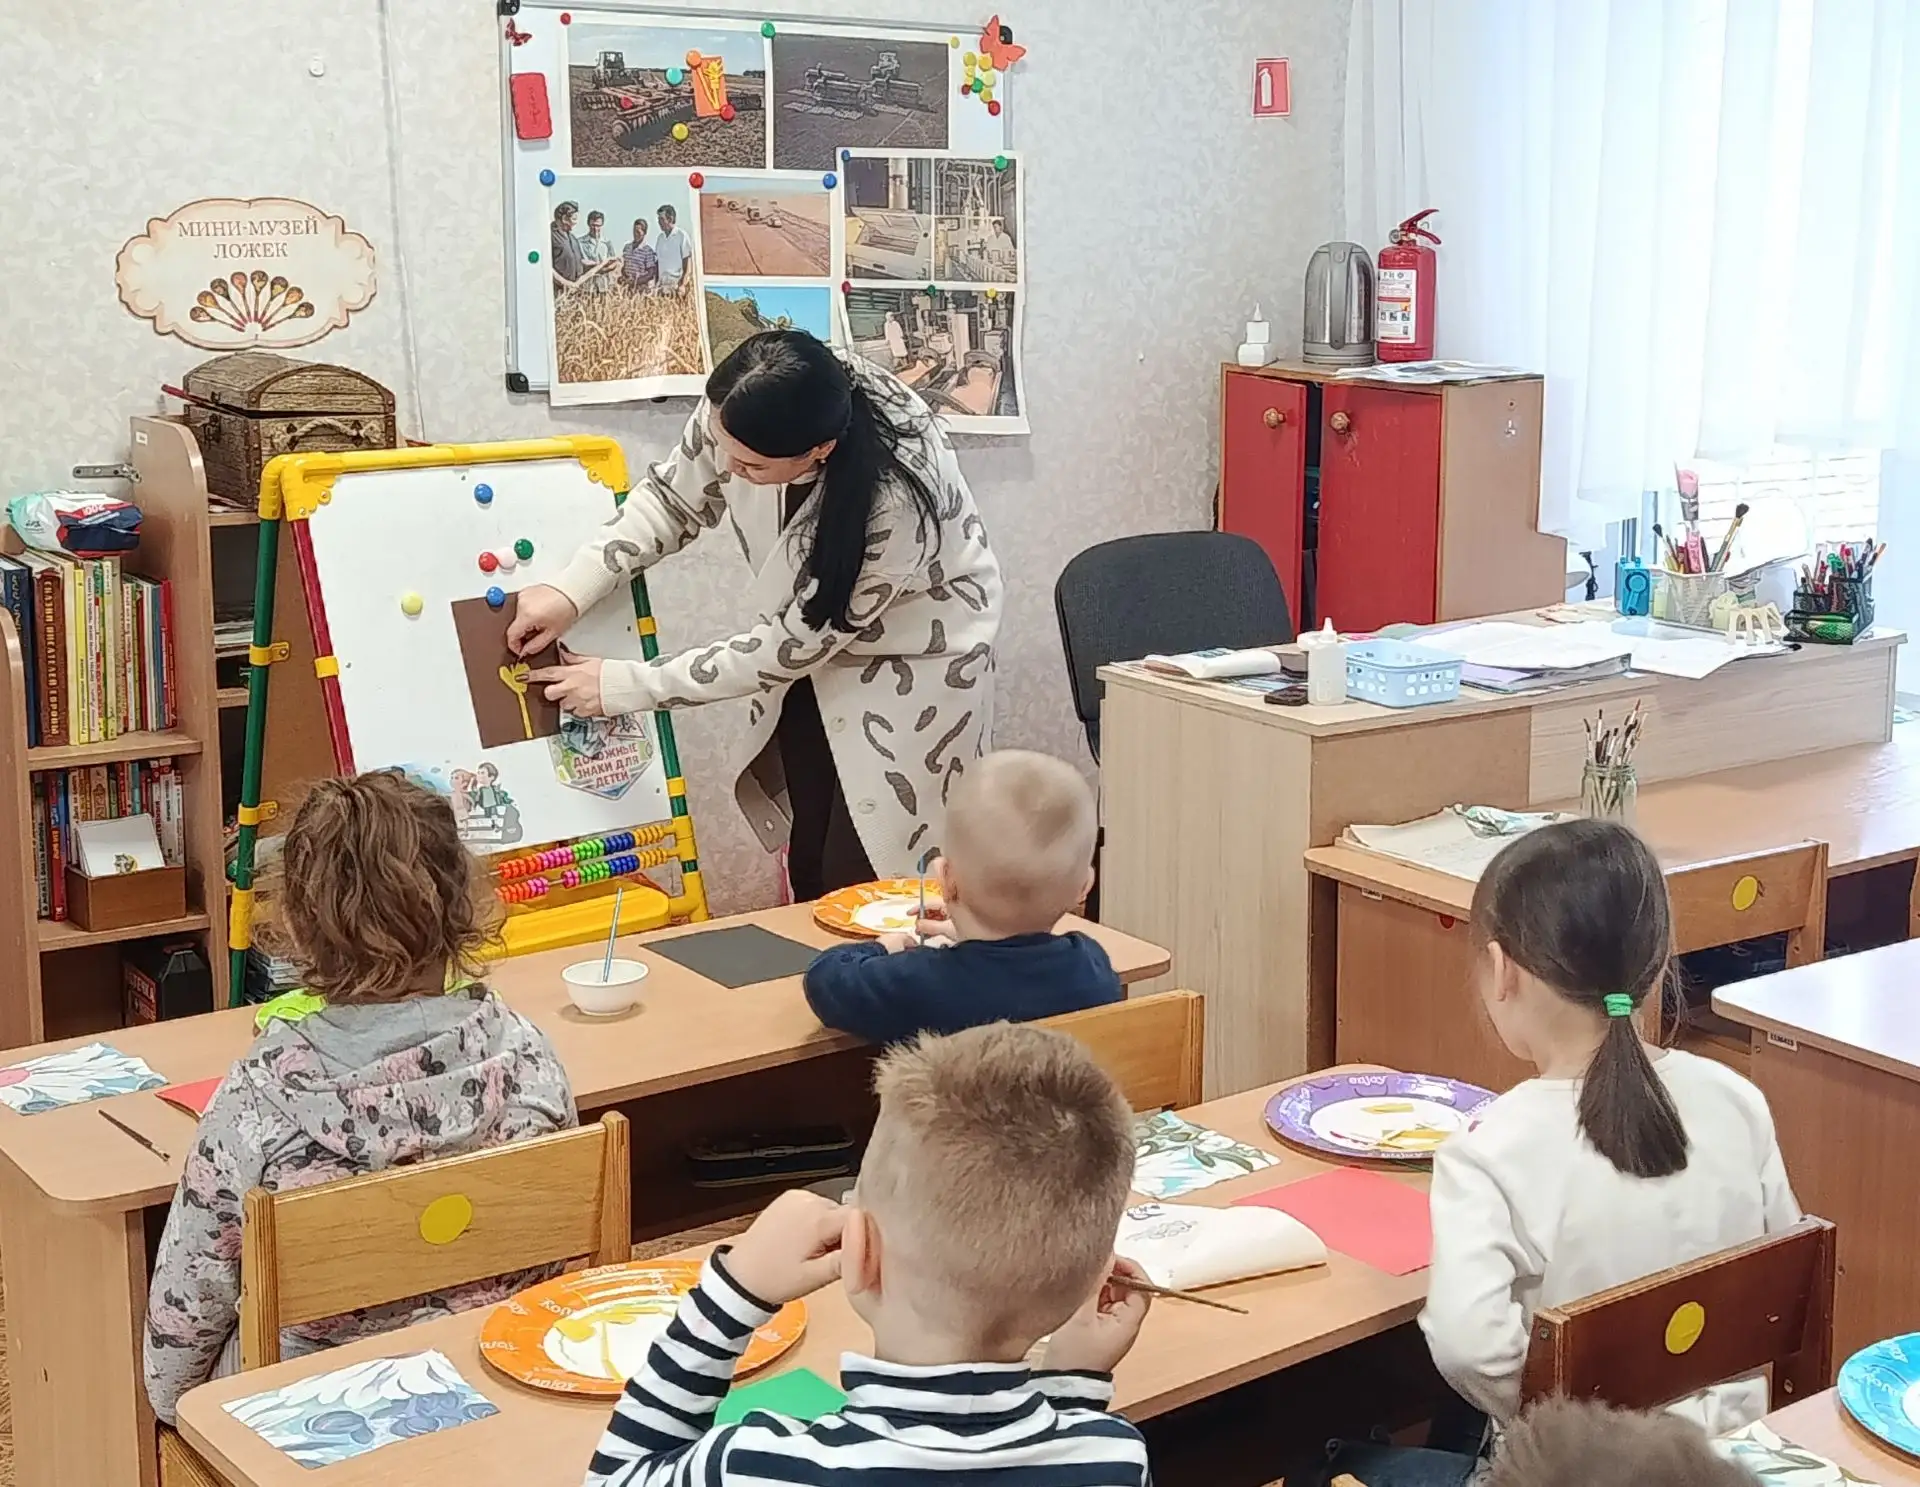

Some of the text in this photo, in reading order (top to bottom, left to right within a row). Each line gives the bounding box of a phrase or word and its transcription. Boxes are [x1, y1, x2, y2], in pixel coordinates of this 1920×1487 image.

[177, 215, 320, 237] МИНИ-МУЗЕЙ
[213, 242, 288, 259] ЛОЖЕК
[43, 581, 59, 735] СКАЗКИ ПИСАТЕЛЕЙ ЕВРОПЫ
[576, 755, 640, 779] ЗНАКИ ДЛЯ
[595, 770, 629, 788] ДЕТЕЙ
[1348, 1075, 1388, 1086] enjoy
